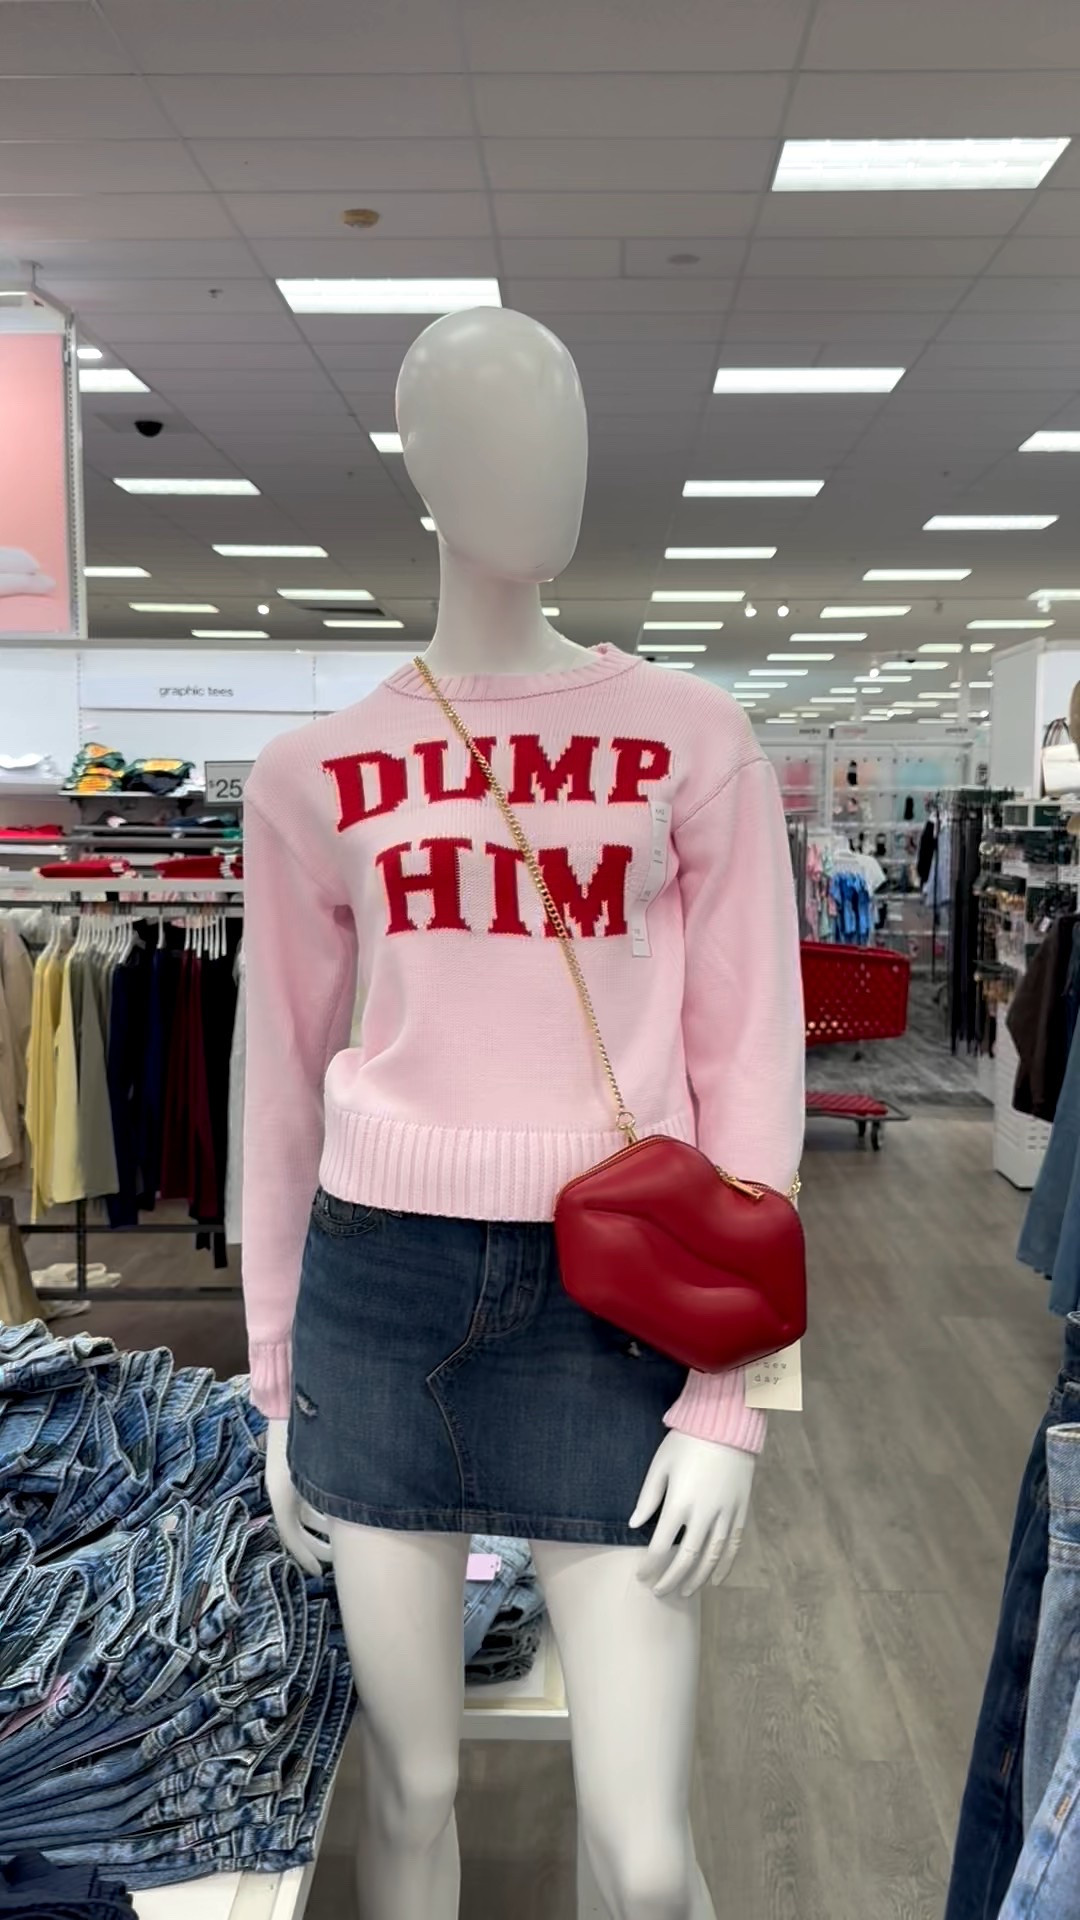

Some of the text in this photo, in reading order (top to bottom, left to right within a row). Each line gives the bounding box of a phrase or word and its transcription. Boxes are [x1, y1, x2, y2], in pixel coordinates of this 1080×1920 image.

[159, 685, 234, 698] graphic tees
[208, 778, 243, 799] $25
[322, 734, 673, 832] DUMP
[375, 837, 633, 938] HIM
[754, 1373, 780, 1385] day
